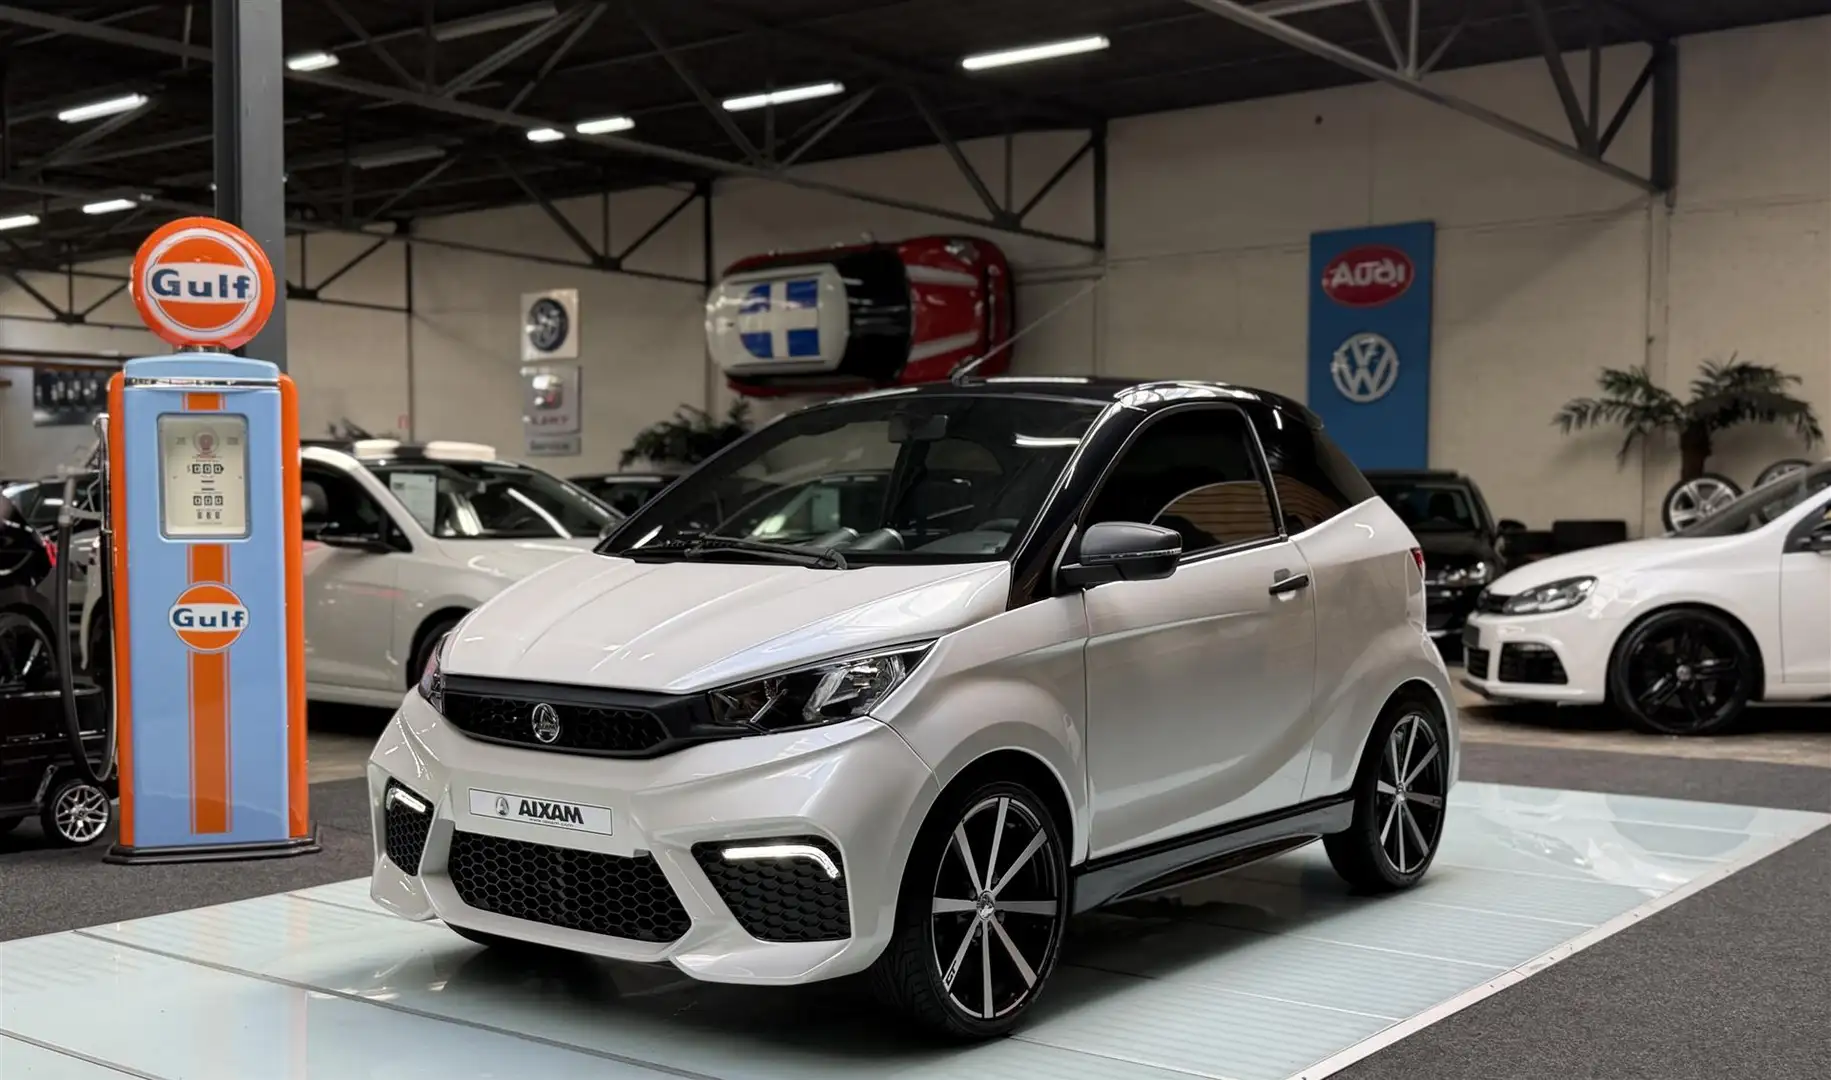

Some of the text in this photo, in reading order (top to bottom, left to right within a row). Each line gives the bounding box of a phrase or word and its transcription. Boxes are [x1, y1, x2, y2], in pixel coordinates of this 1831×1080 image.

[151, 268, 251, 298] Gulf
[172, 608, 245, 627] Gulf
[518, 799, 584, 824] AIXAM
